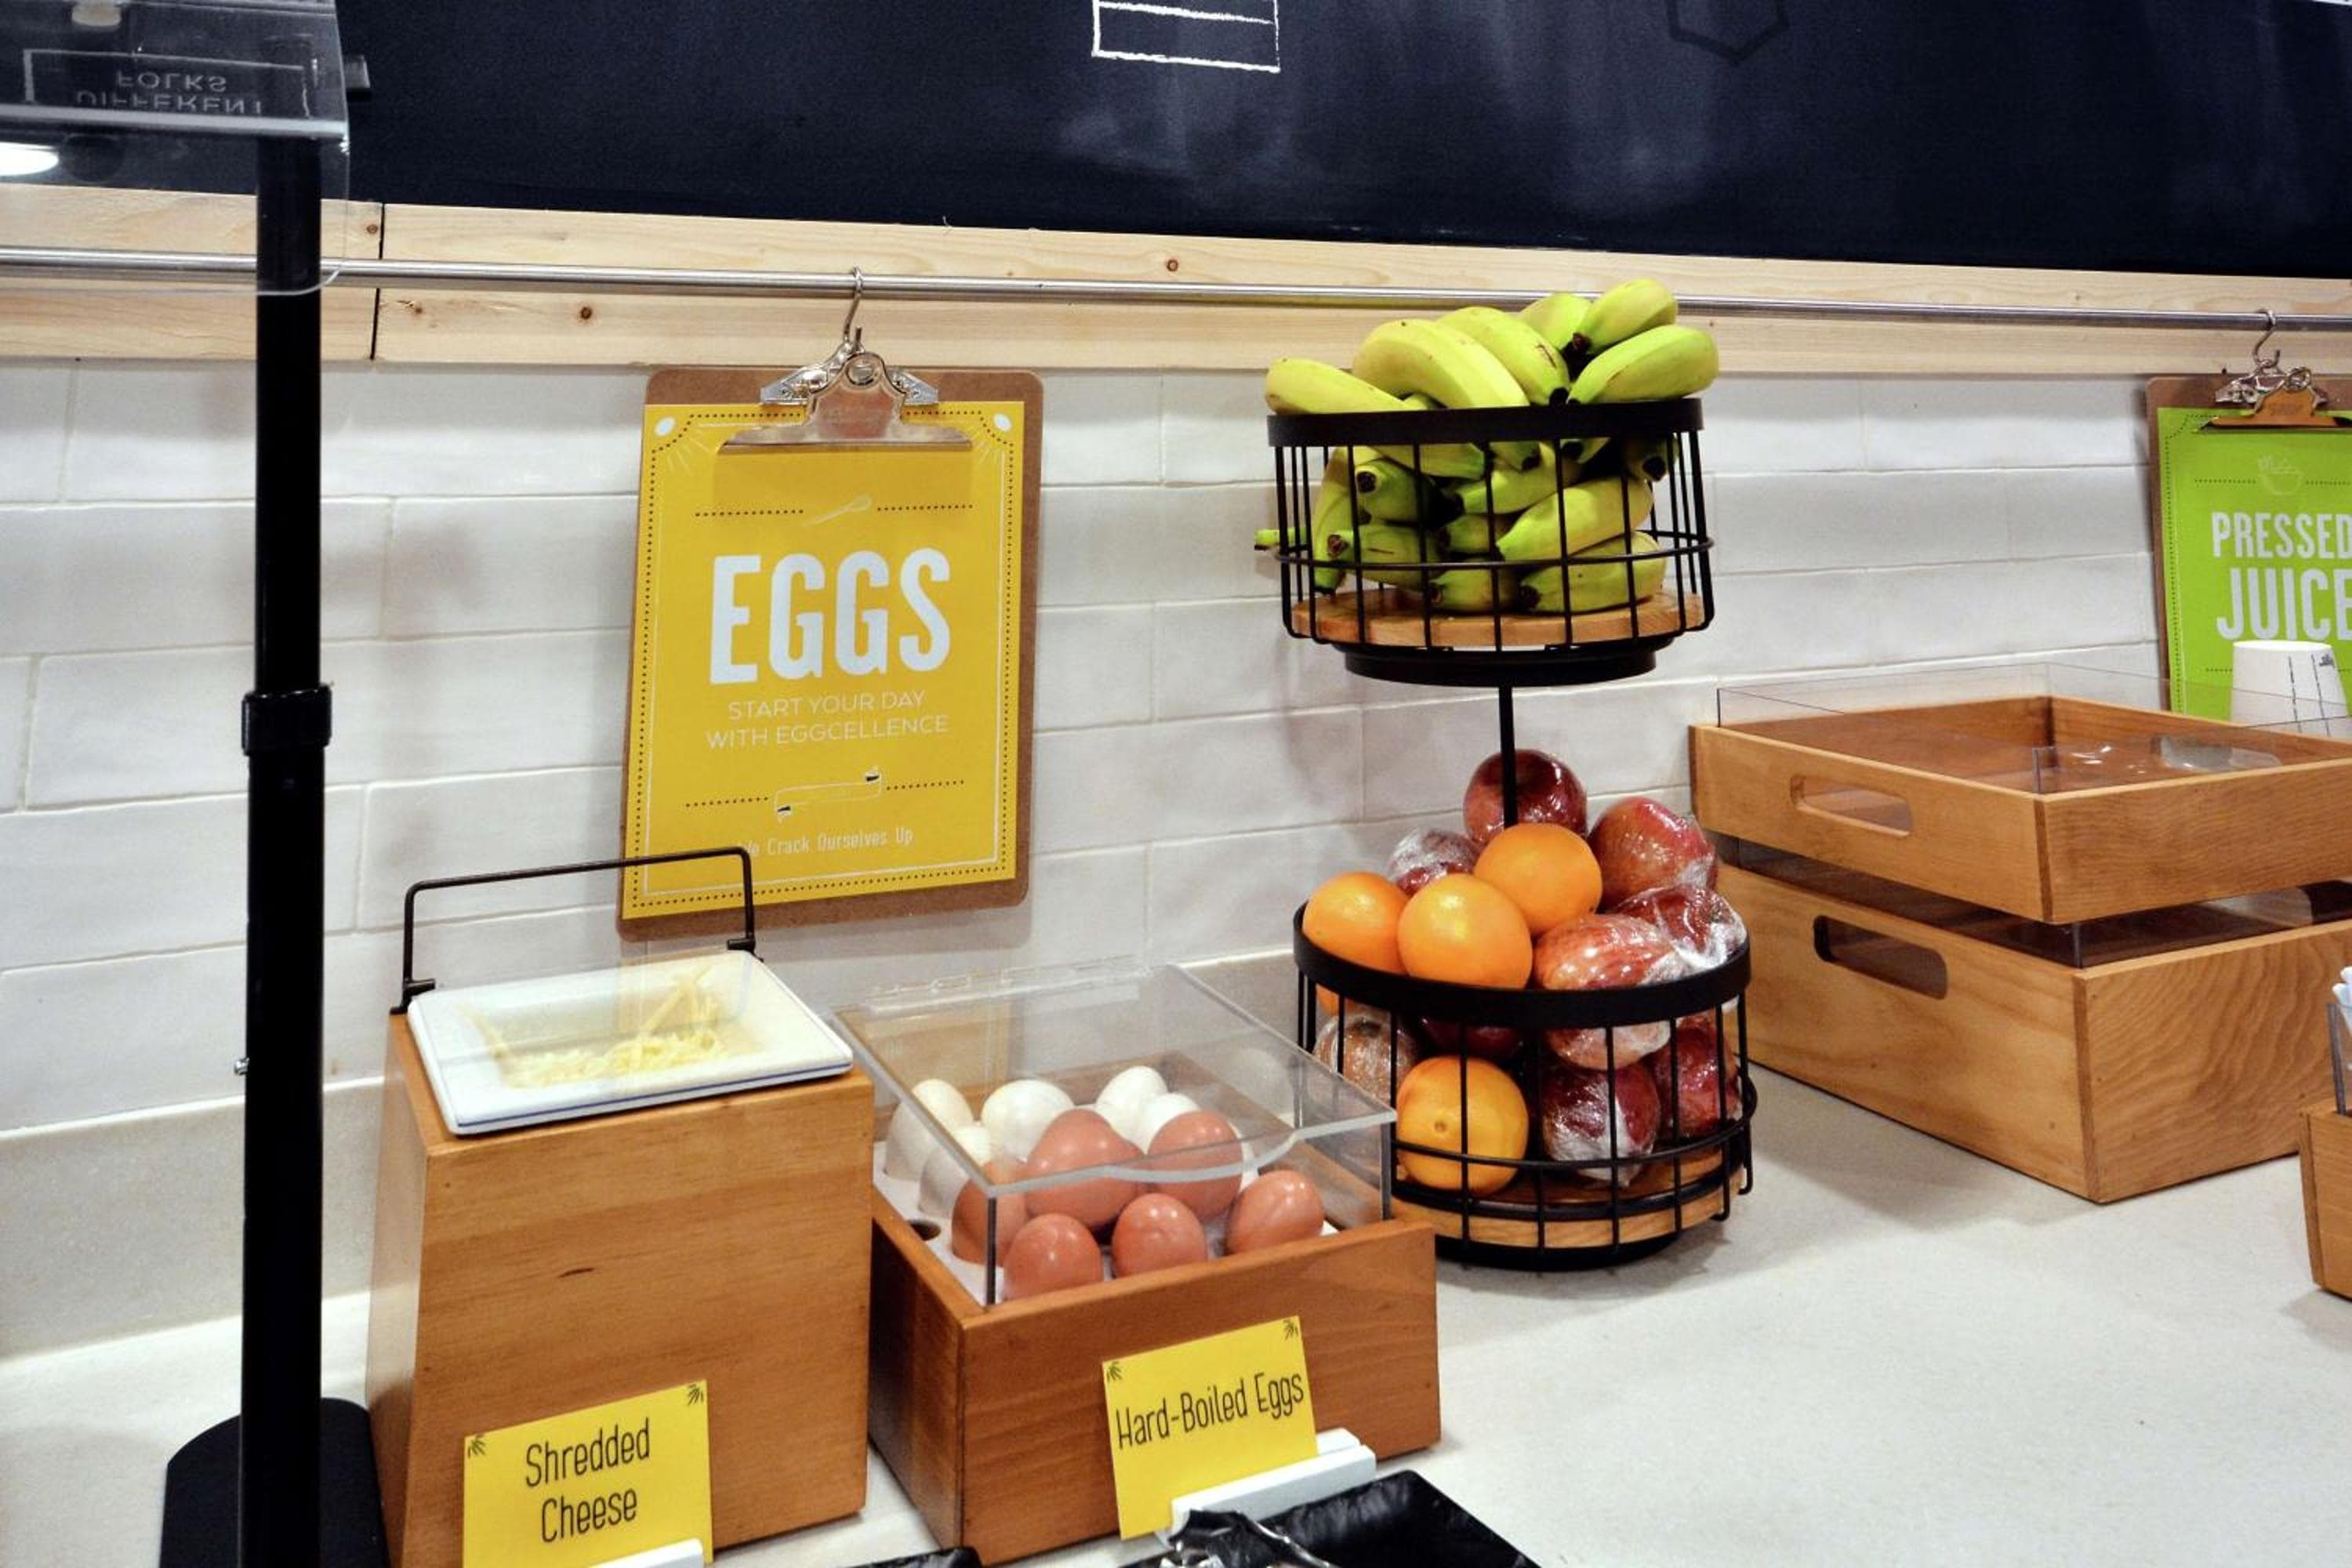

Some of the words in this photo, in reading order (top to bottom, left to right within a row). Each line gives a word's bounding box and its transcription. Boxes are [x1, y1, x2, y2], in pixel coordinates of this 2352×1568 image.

[2212, 512, 2352, 559] PRESSED
[710, 548, 951, 684] EGGS
[728, 698, 803, 721] START
[808, 693, 874, 714] YOUR
[881, 689, 926, 710] DAY
[707, 728, 768, 750] WITH
[776, 714, 949, 744] EGGCELLENCE
[767, 836, 810, 855] Crack
[817, 829, 887, 851] Ourselves
[896, 827, 913, 845] Up
[1116, 1378, 1247, 1450] Hard-Boiled
[1255, 1373, 1304, 1420] Eggs
[525, 1417, 650, 1487] Shredded
[542, 1489, 637, 1543] Cheese
